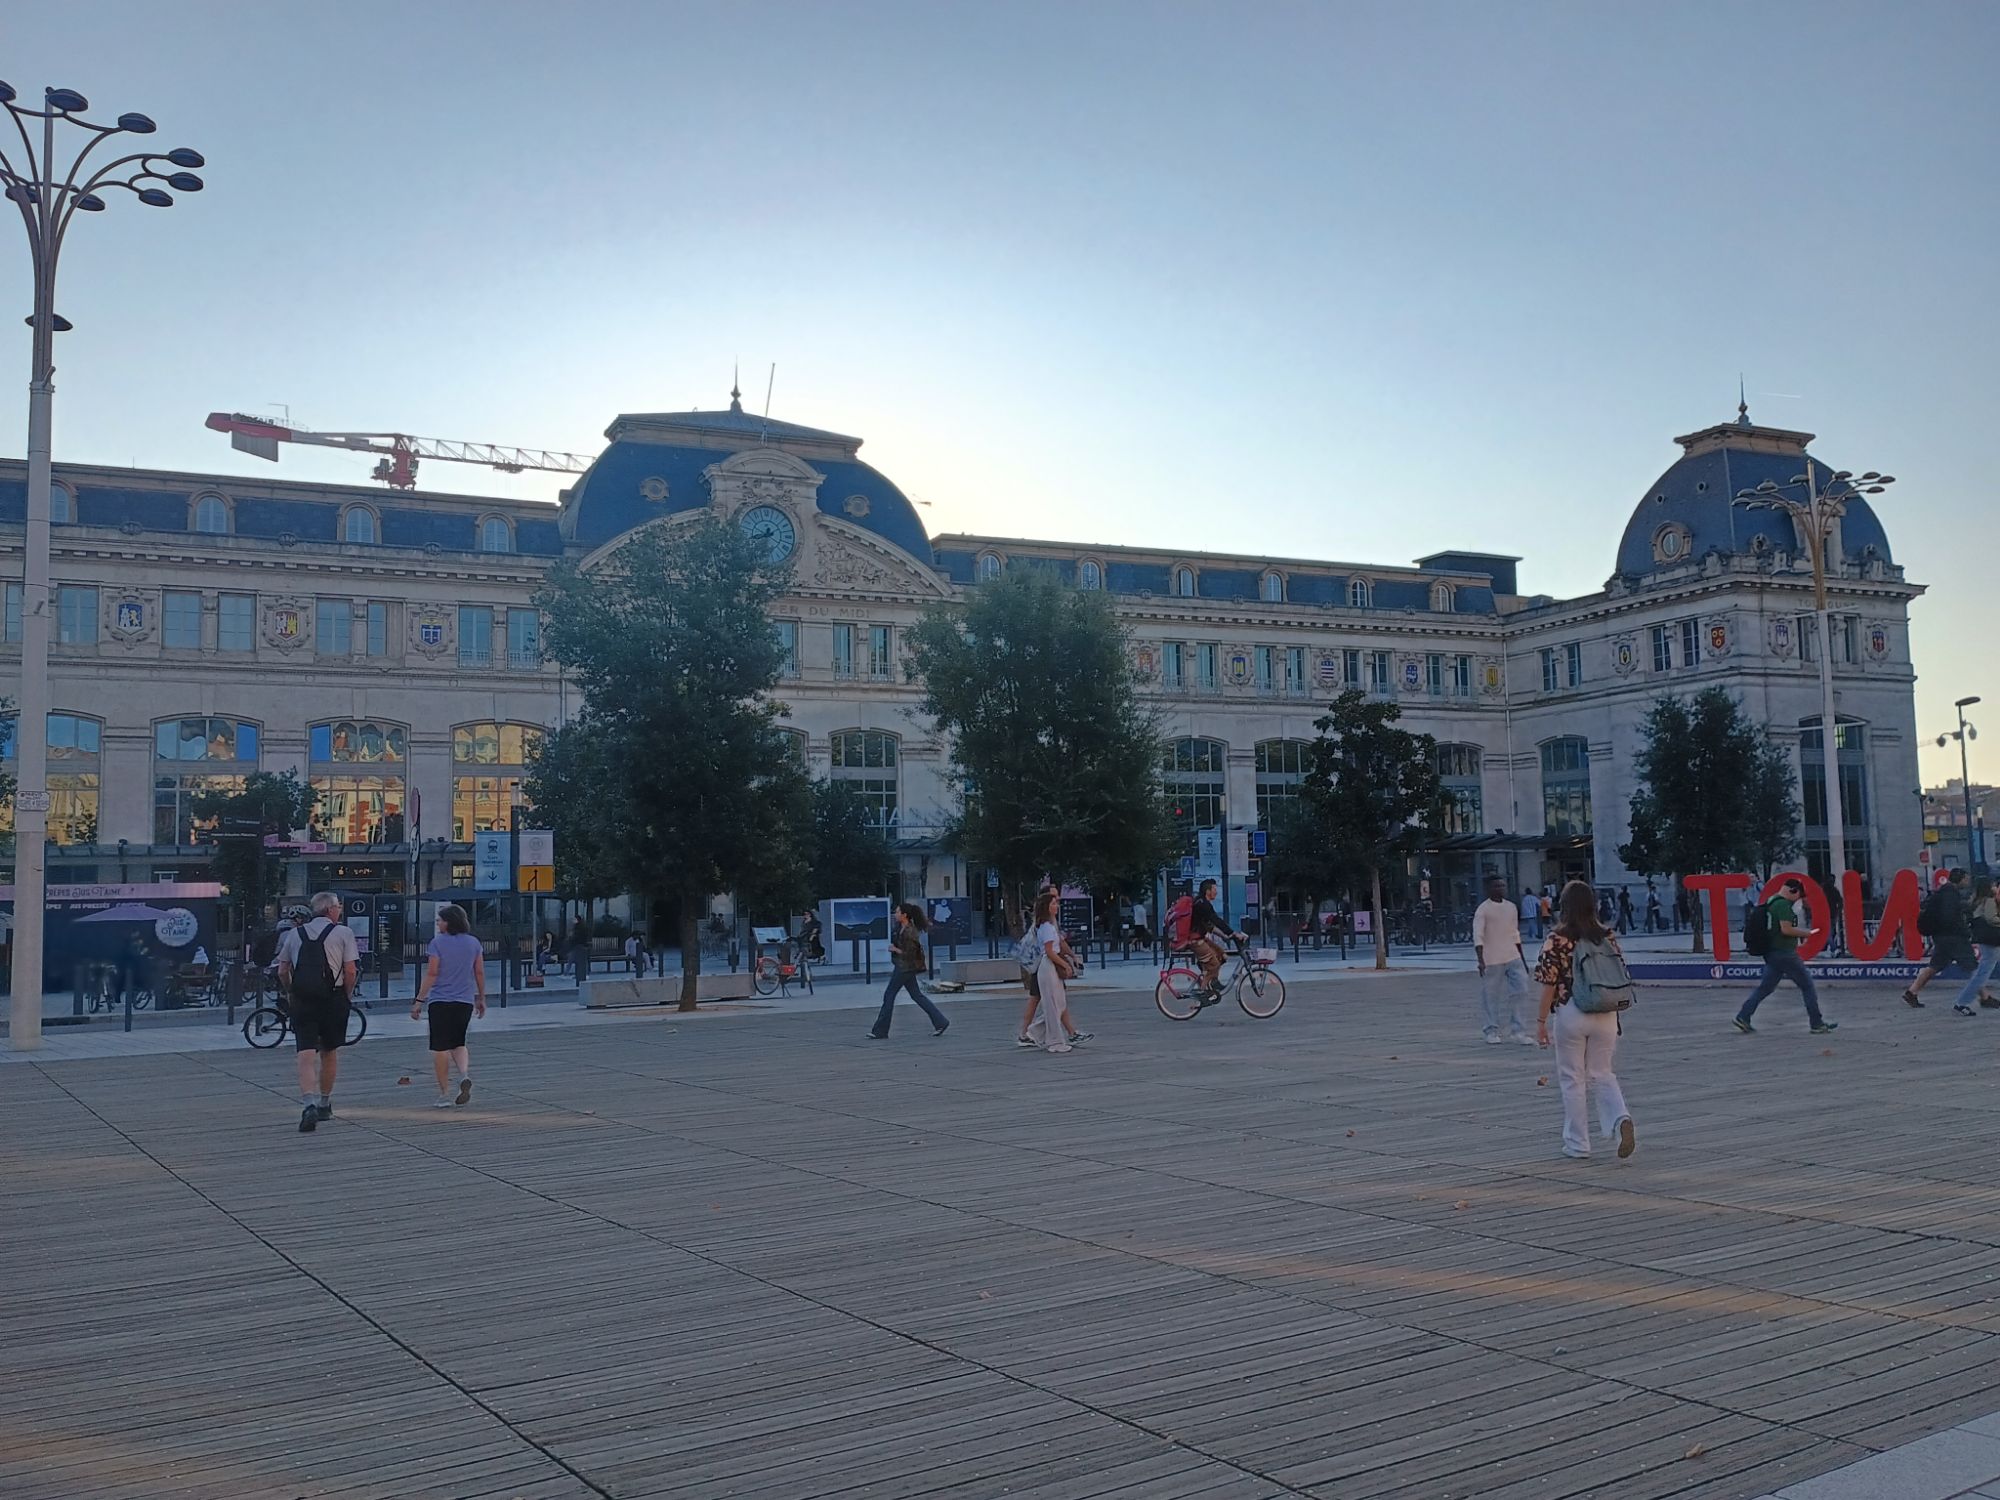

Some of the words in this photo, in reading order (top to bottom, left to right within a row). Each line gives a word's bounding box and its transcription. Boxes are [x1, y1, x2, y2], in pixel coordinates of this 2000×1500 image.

[809, 606, 829, 616] DU
[839, 608, 869, 618] MIDI
[1680, 868, 1948, 962] TOU
[1726, 967, 1762, 977] COUPE
[1826, 967, 1864, 977] RUGBY
[1866, 967, 1910, 977] FRANCE
